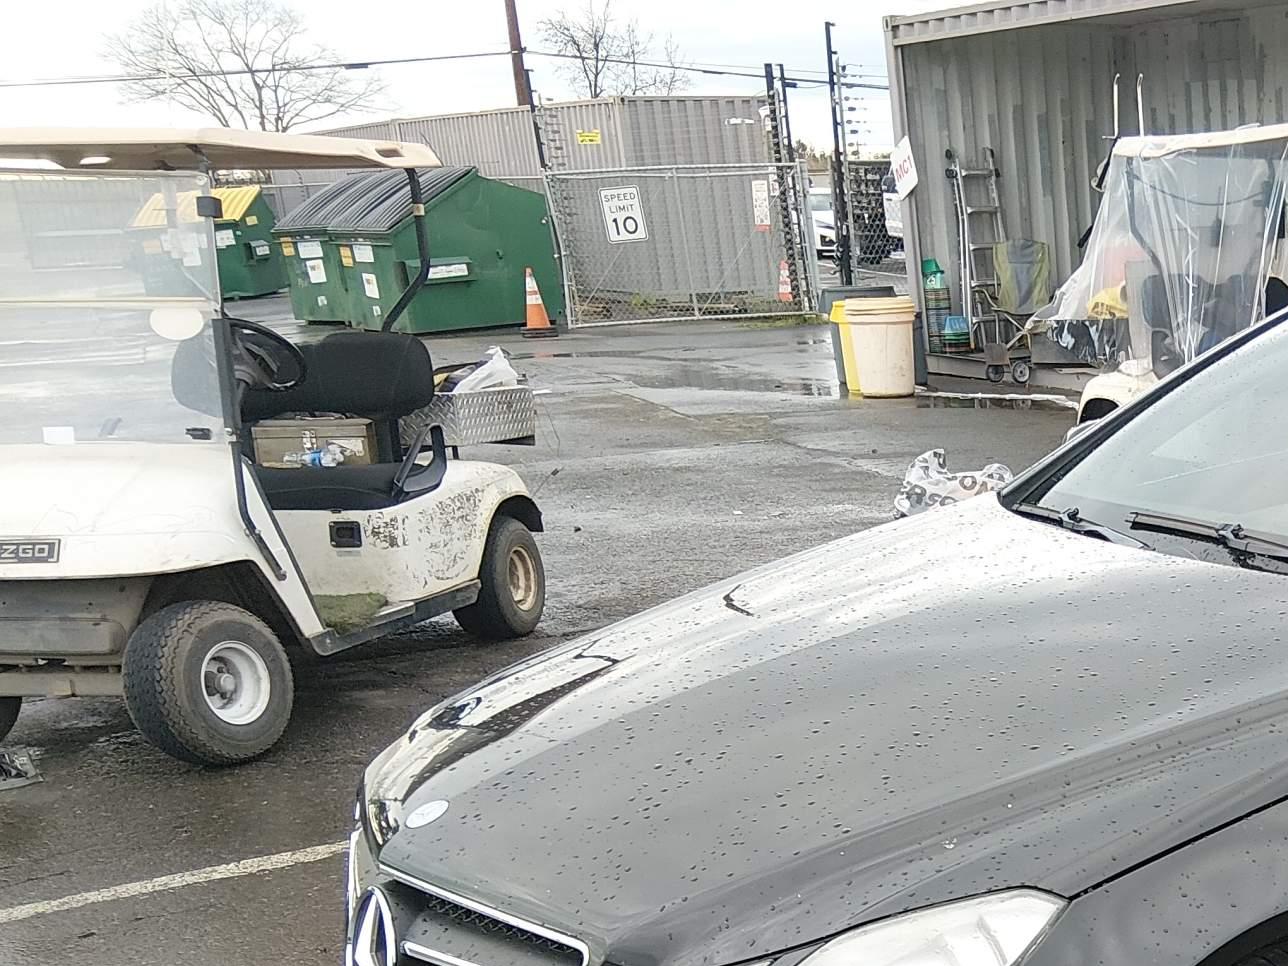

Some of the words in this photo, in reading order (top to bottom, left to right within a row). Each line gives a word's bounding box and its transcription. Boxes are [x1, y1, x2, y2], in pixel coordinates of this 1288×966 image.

[604, 192, 636, 203] SPEED
[609, 204, 634, 214] LIMIT
[612, 216, 638, 236] 10
